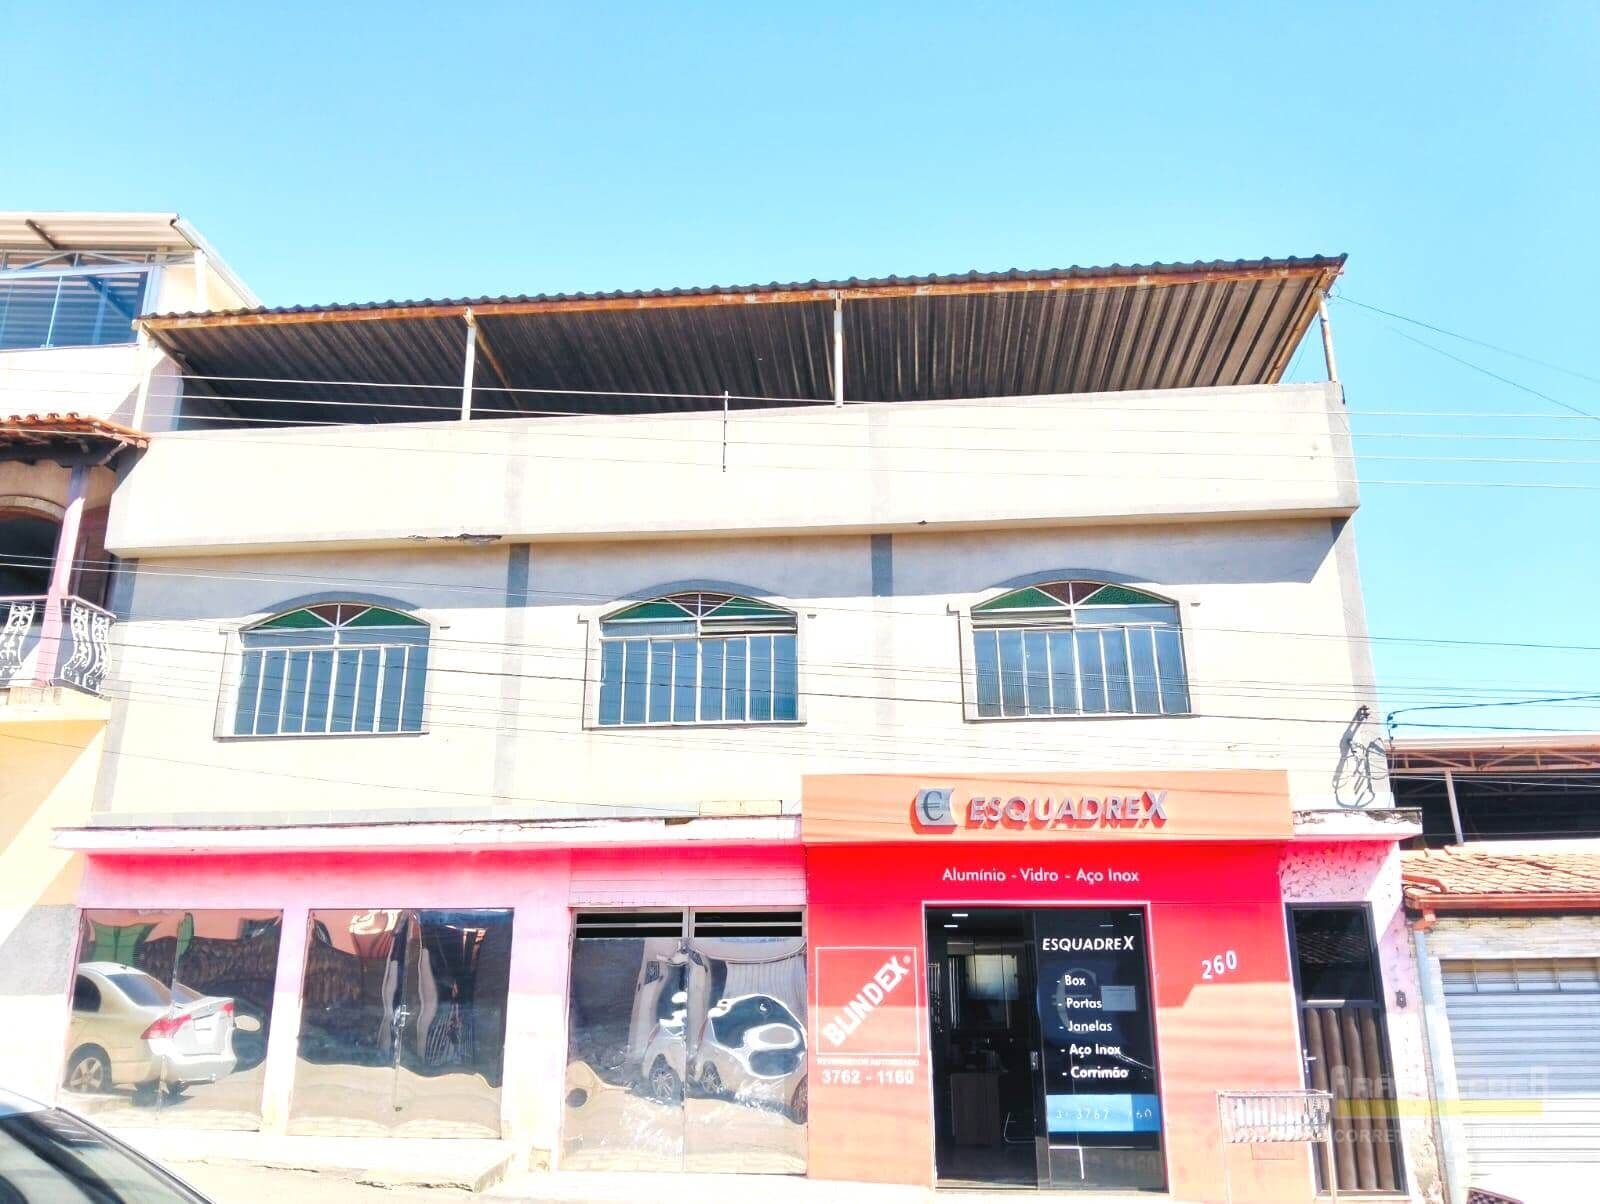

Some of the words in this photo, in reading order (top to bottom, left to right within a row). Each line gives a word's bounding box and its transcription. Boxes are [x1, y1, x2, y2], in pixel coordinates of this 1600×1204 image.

[969, 789, 1168, 823] ESQUADREX
[942, 867, 1006, 882] Alumínio
[1020, 867, 1059, 882] Vidro
[1076, 867, 1104, 885] Aço
[1108, 867, 1140, 882] Inox
[1042, 936, 1135, 952] ESQUADREX
[1201, 950, 1238, 980] 260
[1064, 975, 1087, 986] Box
[1066, 997, 1103, 1009] Portas
[1067, 1020, 1112, 1032] Janelas
[1069, 1043, 1092, 1059] Aço
[1095, 1043, 1121, 1055] Inox
[822, 1068, 862, 1085] 3762
[1070, 1065, 1129, 1079] Corrimão
